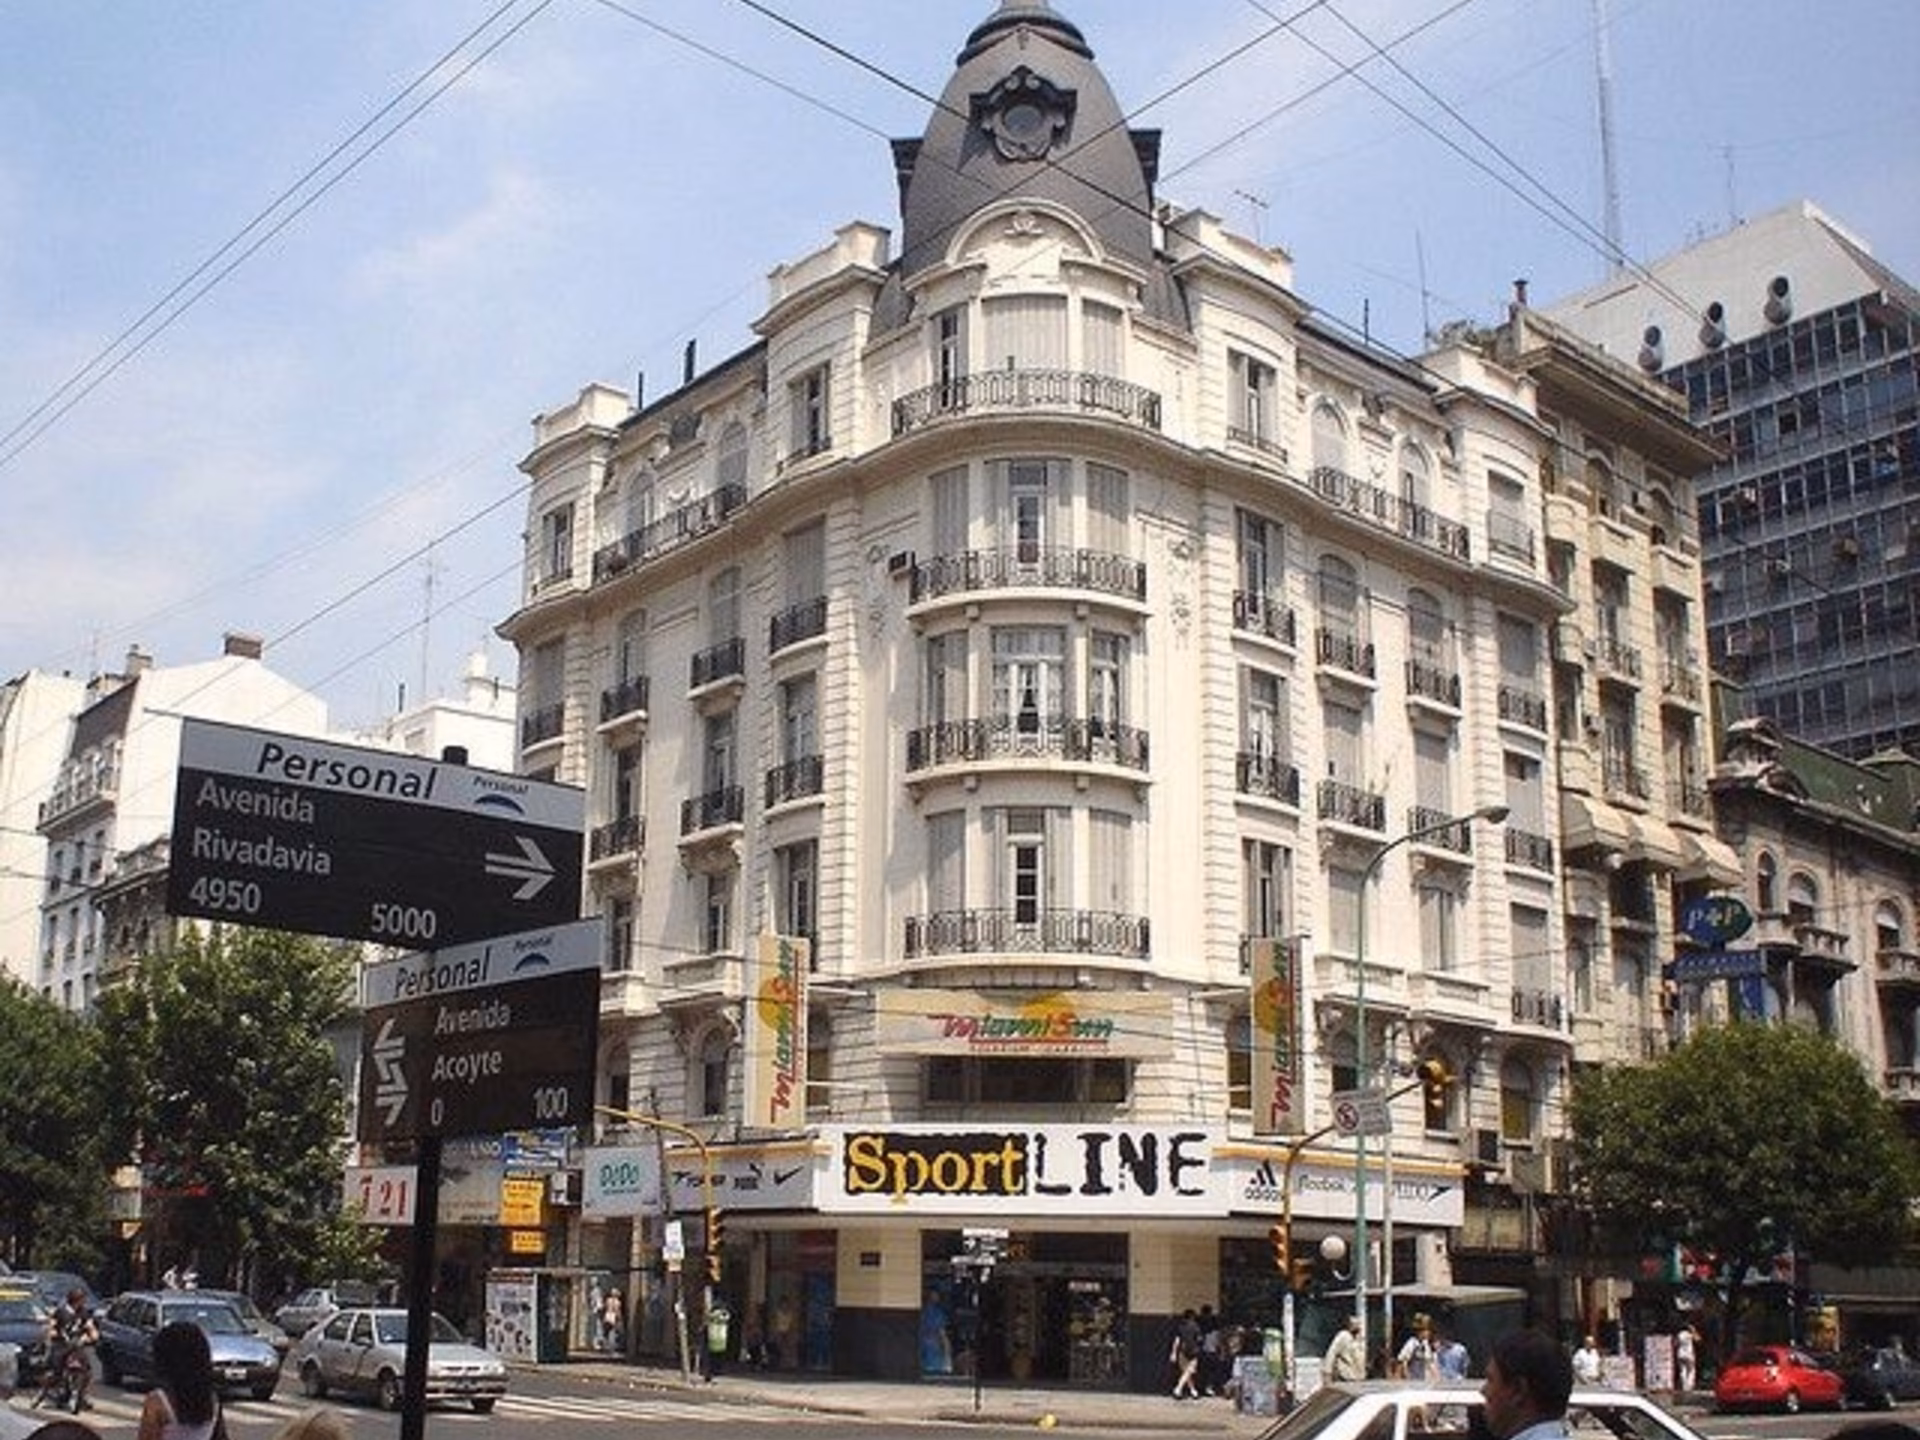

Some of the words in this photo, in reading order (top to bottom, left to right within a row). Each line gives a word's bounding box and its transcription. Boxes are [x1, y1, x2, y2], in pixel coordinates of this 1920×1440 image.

[257, 741, 438, 800] Personal
[473, 775, 529, 796] Personal
[196, 777, 315, 824] Avenida
[193, 827, 332, 875] Rivadavia
[189, 876, 262, 913] 4950
[371, 904, 437, 939] 5000
[393, 944, 492, 999] Personal
[434, 1000, 512, 1035] Avenida
[432, 1050, 502, 1084] Acoyte
[431, 1098, 445, 1126] 0
[533, 1087, 569, 1119] 100
